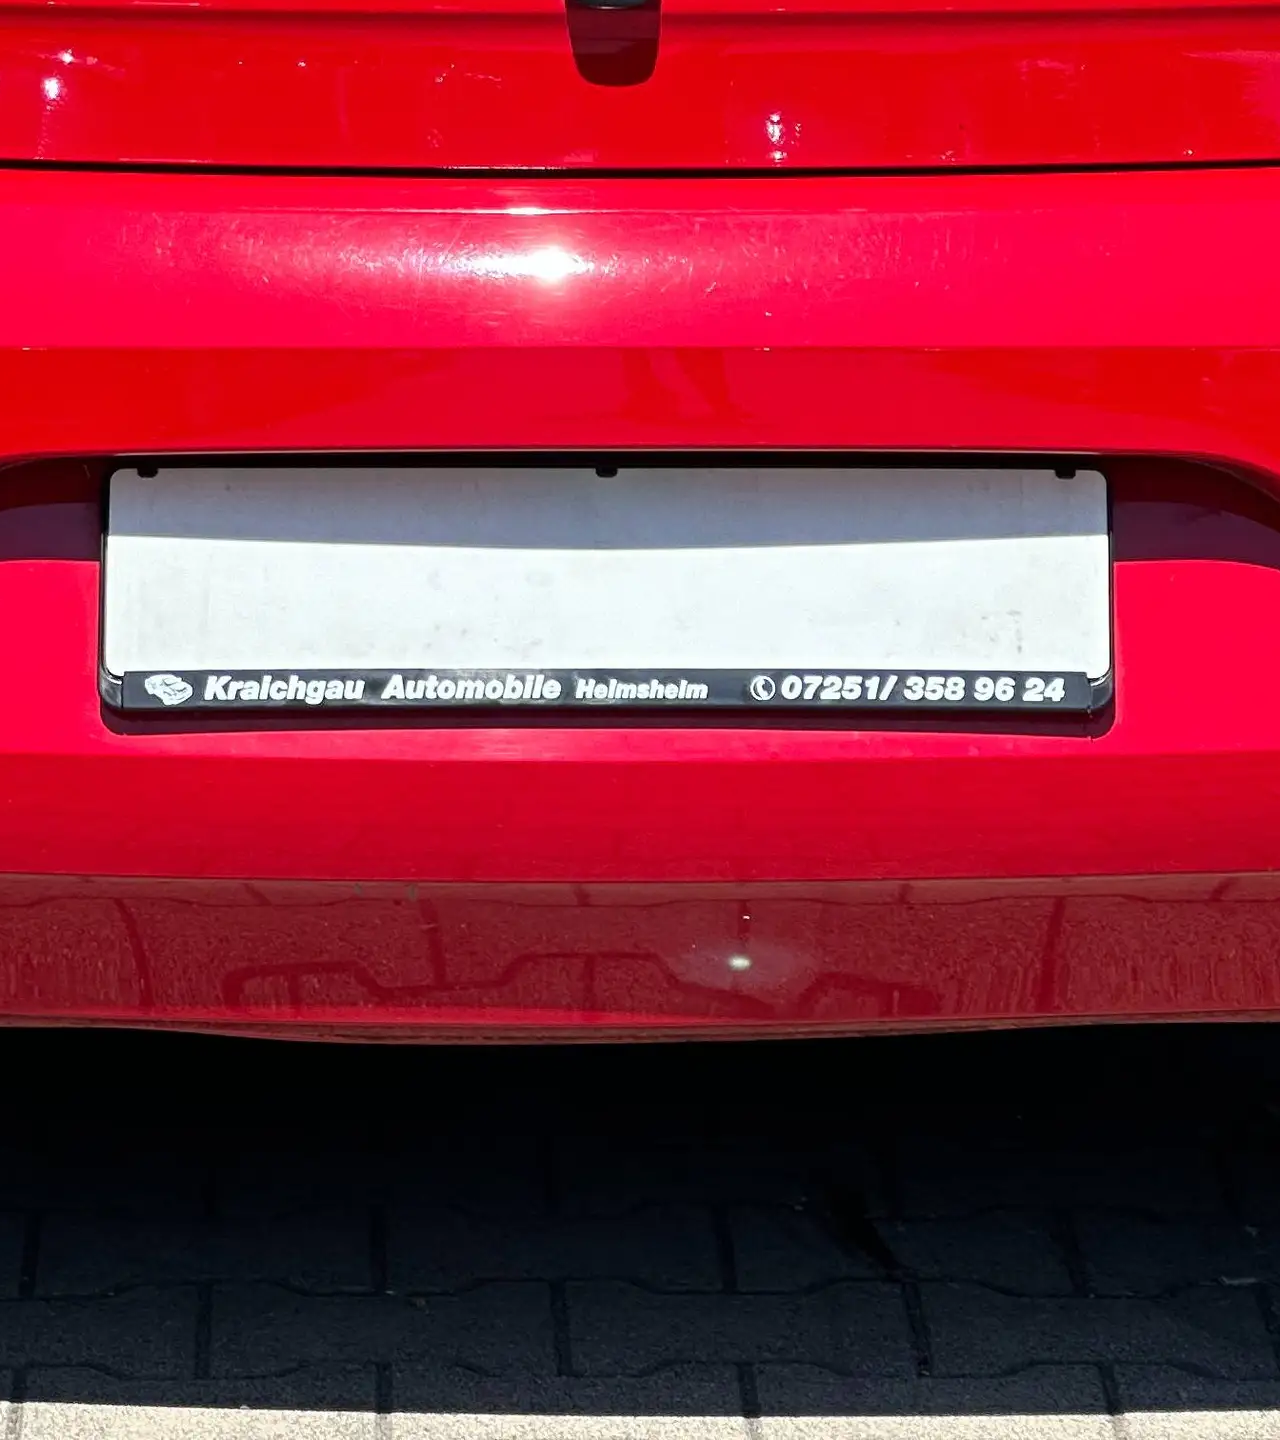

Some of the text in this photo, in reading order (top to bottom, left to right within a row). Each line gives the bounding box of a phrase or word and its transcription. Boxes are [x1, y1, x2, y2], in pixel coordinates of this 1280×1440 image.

[204, 674, 366, 705] Kraichgau
[380, 673, 562, 700] Automobile
[780, 675, 898, 701] 07251/
[903, 676, 966, 701] 358
[973, 676, 1016, 702] 96
[1021, 677, 1066, 702] 24
